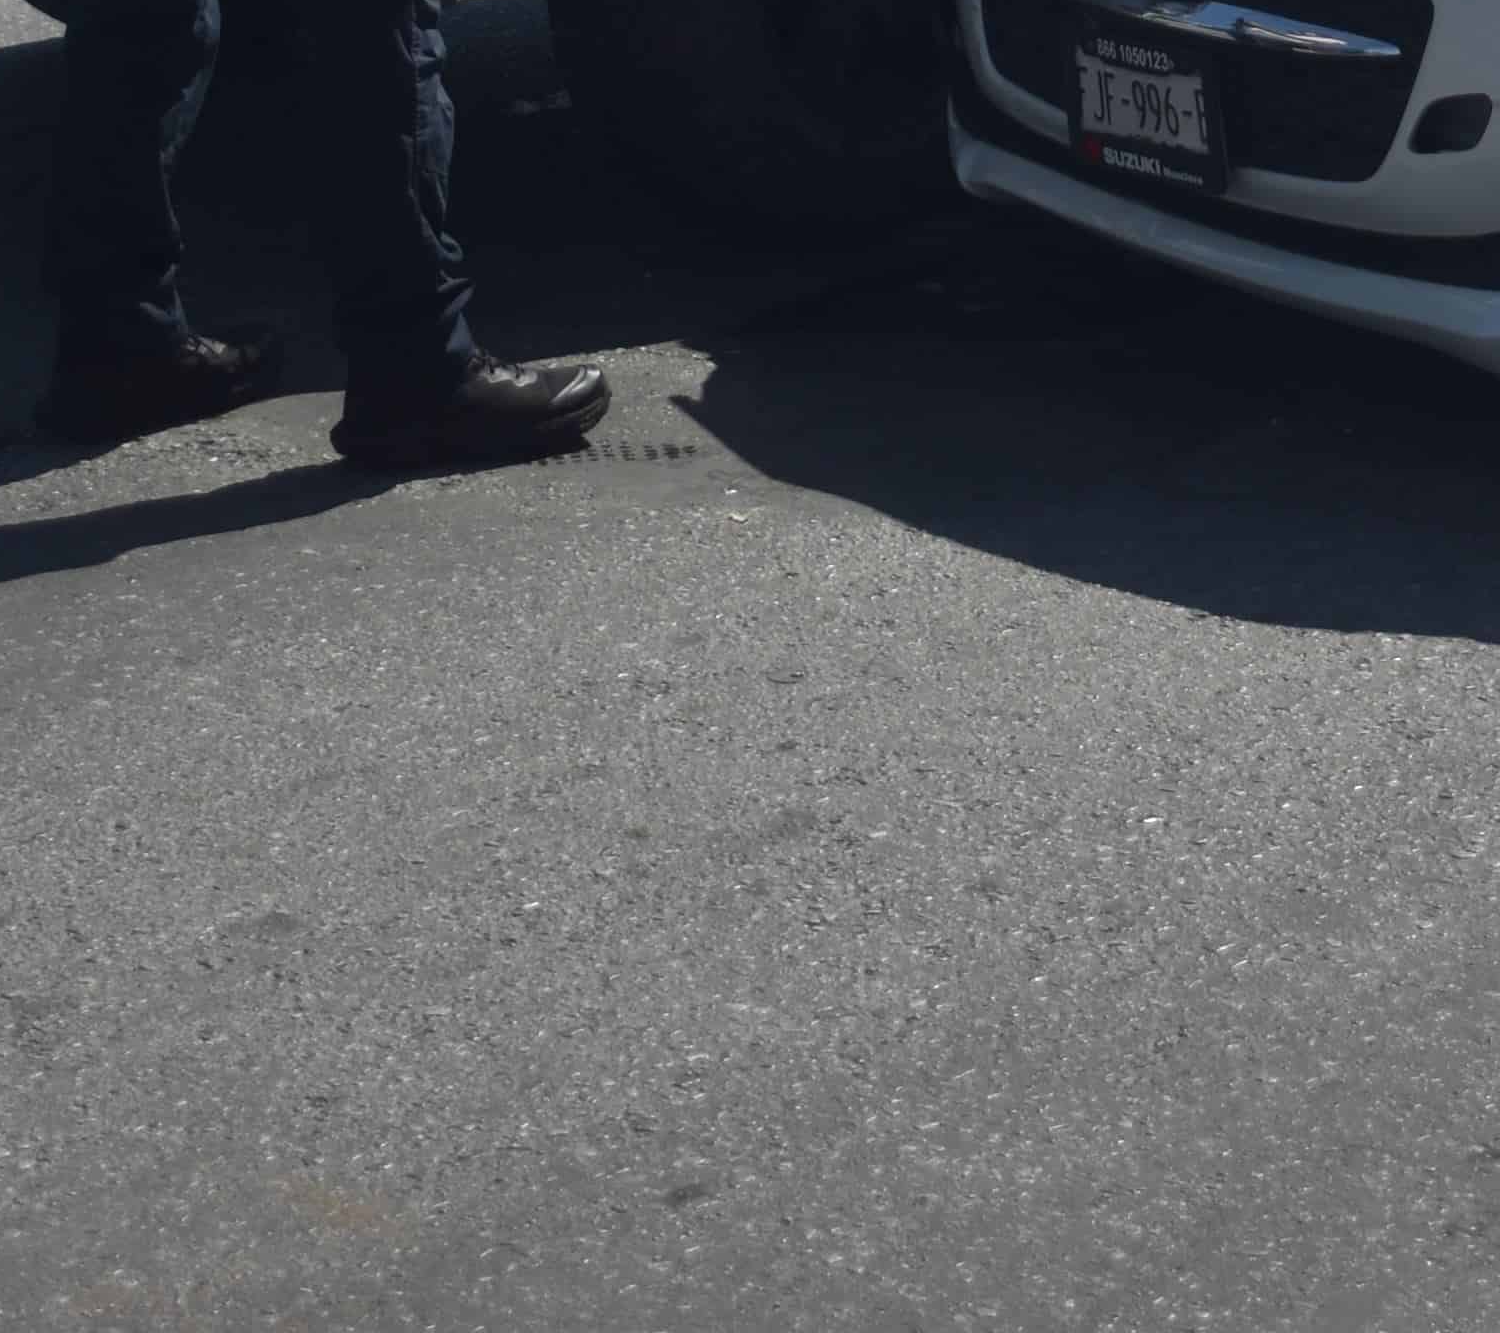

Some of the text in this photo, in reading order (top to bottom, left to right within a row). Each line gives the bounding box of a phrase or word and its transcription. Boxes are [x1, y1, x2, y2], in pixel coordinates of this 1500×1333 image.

[1119, 43, 1171, 71] 1050123
[1076, 65, 1207, 147] JF-996-
[1102, 146, 1161, 176] SUZUKI
